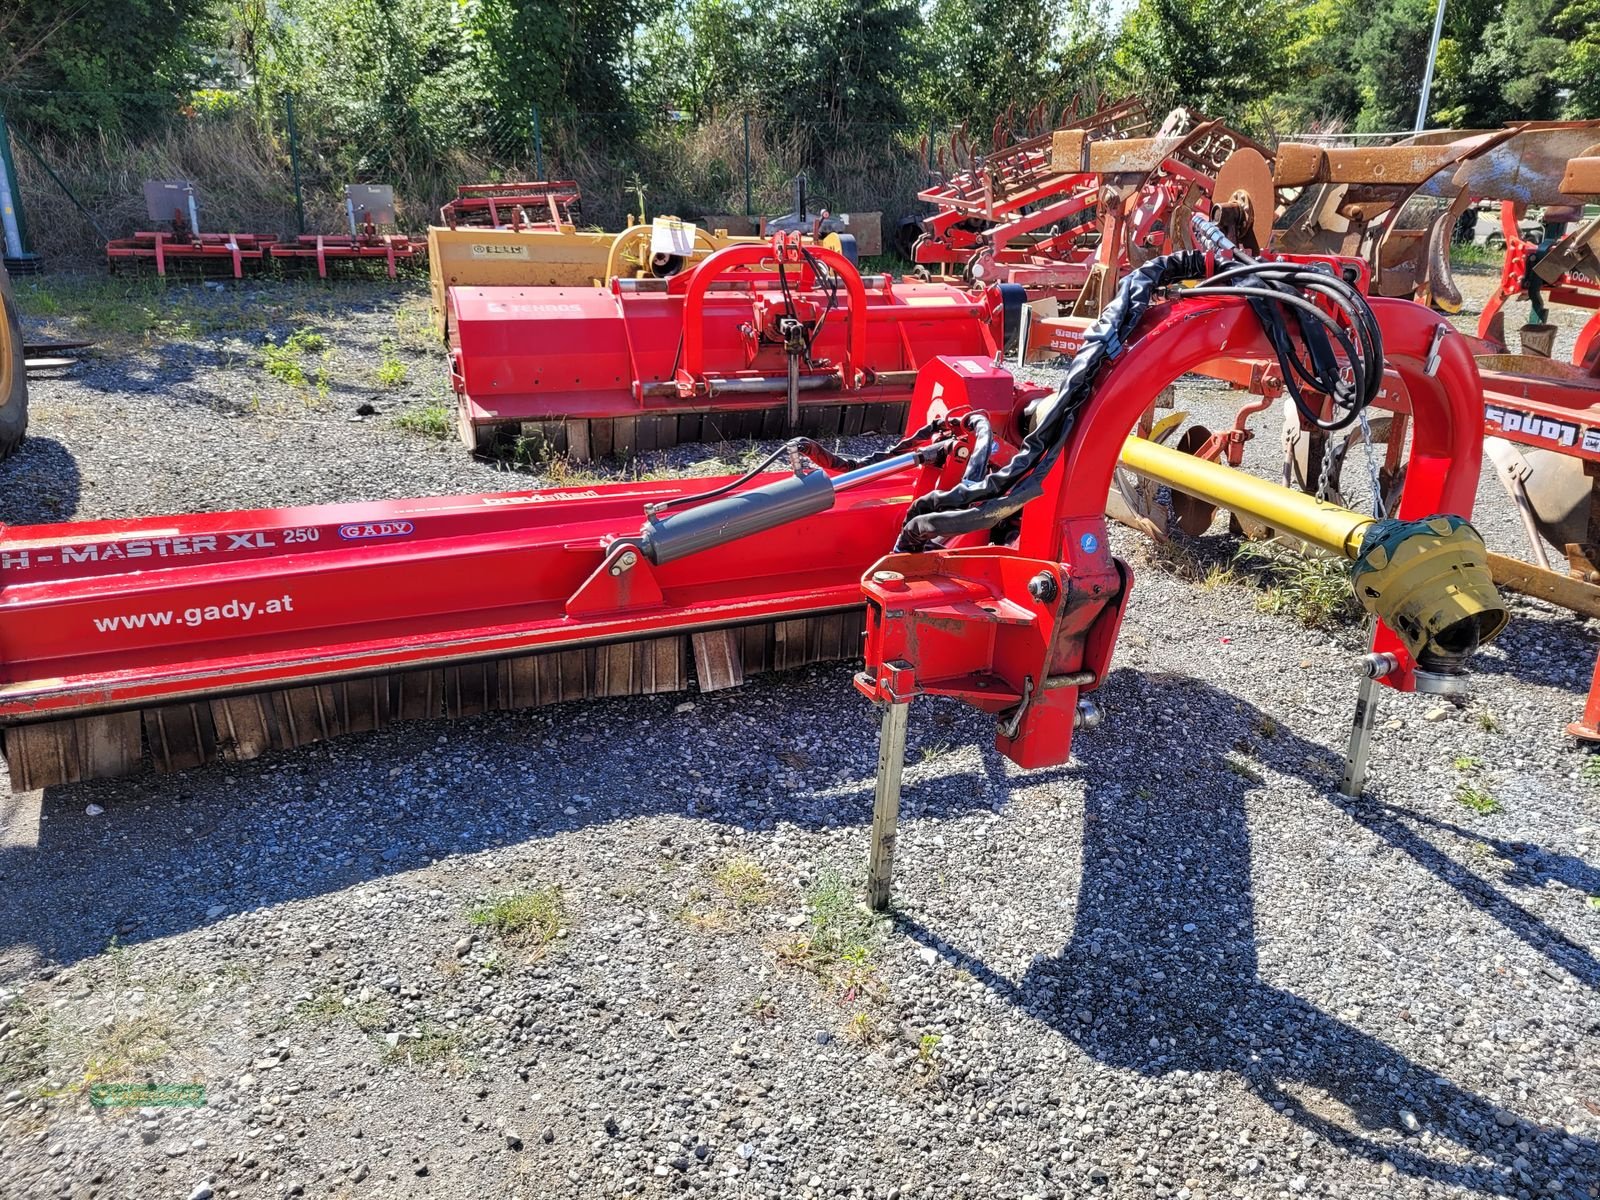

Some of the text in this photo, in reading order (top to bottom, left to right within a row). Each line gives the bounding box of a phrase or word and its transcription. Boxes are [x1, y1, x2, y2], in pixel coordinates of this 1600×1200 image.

[227, 532, 276, 551] XL
[283, 528, 320, 543] 250
[347, 523, 409, 537] GADY
[93, 594, 294, 633] www.gady.at
